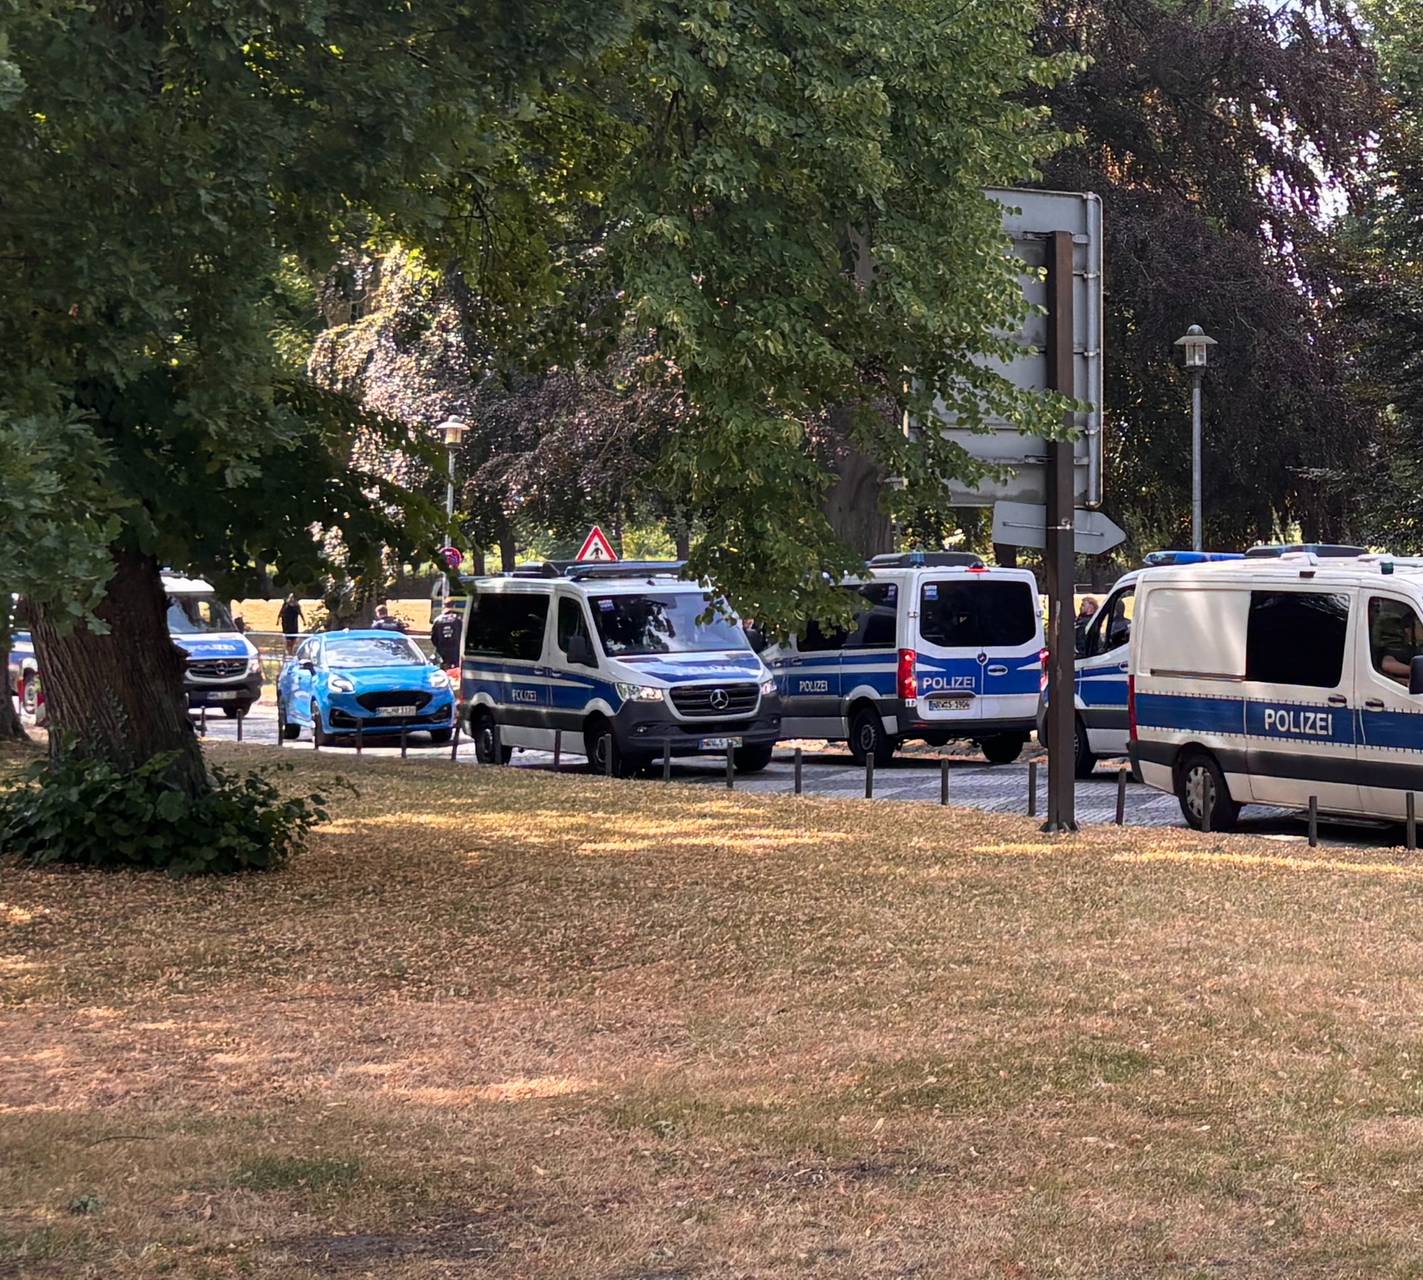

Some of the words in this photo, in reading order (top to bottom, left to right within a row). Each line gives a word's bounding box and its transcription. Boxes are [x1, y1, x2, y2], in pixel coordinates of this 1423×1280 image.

[799, 680, 828, 692] POLIZEI
[922, 676, 976, 690] POLIZEI
[1264, 708, 1333, 736] POLIZEI
